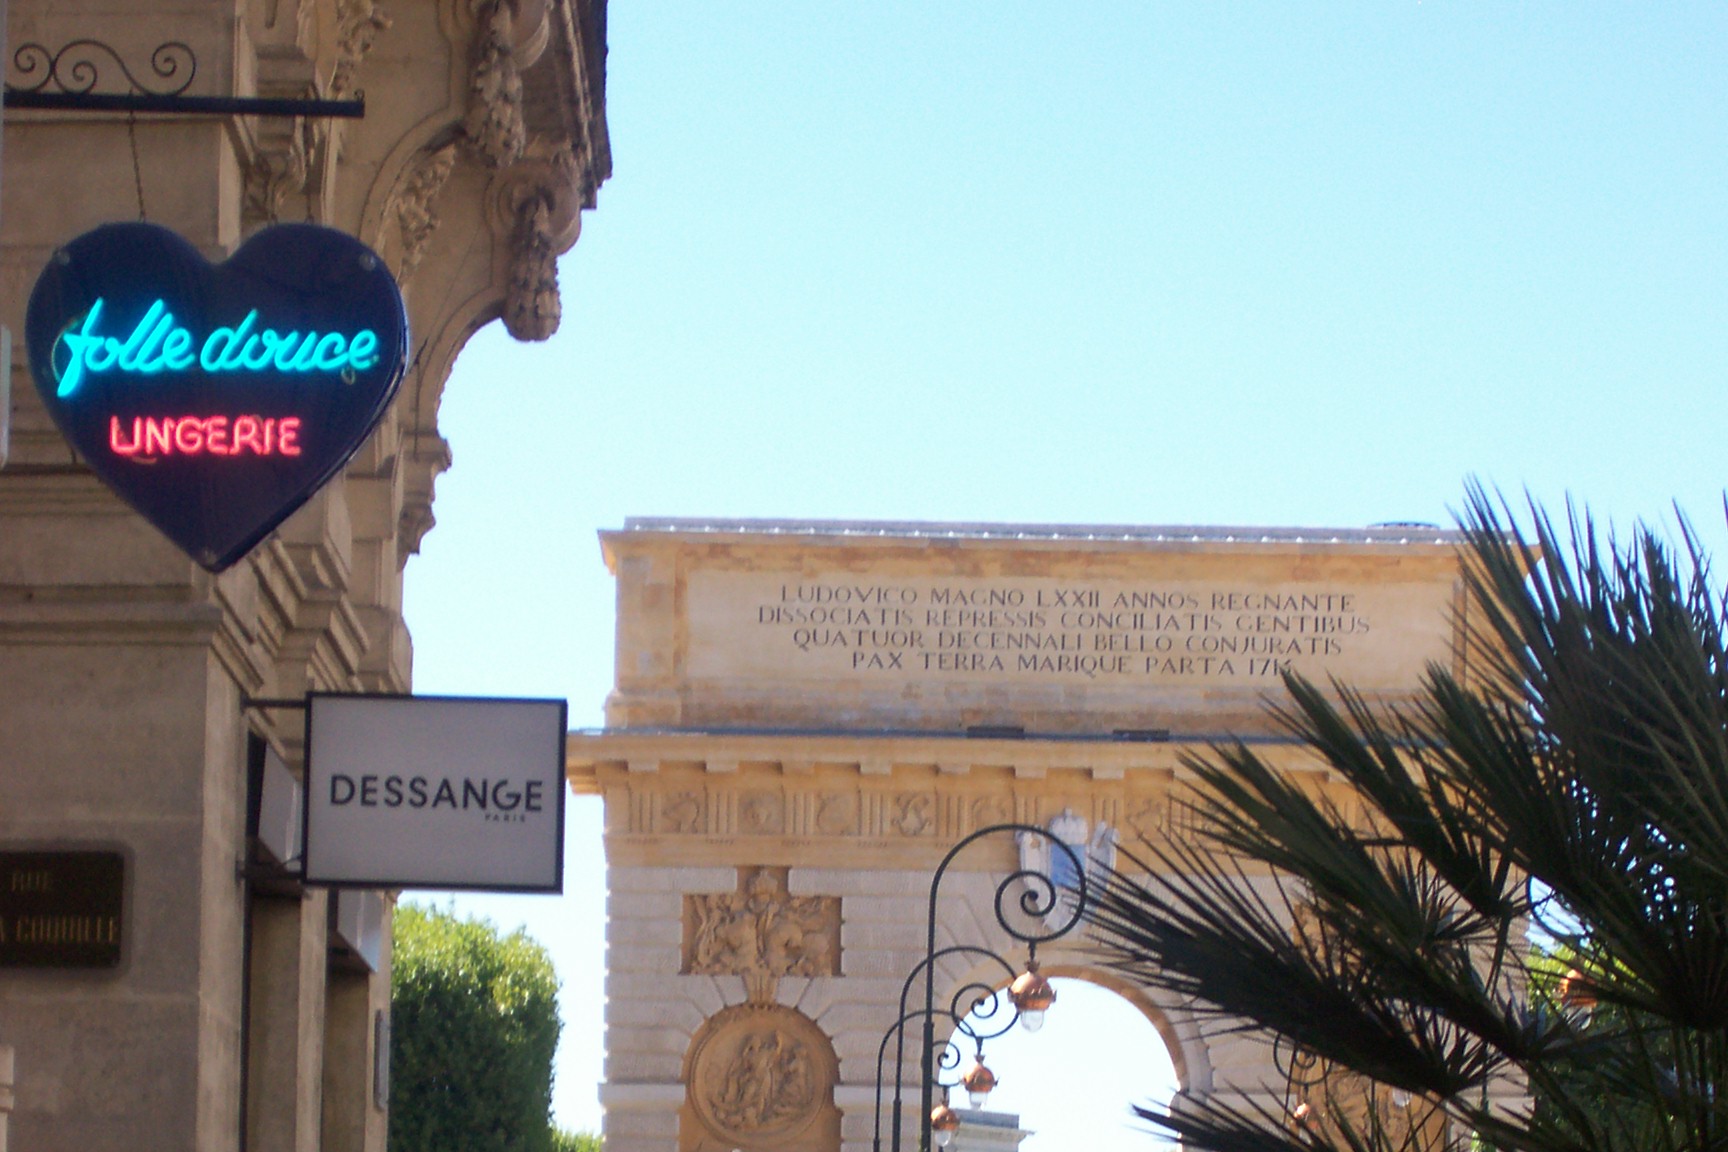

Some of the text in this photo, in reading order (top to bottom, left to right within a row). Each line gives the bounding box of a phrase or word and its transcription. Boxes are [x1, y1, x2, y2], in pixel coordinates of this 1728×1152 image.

[57, 296, 378, 397] folle douce
[109, 414, 302, 457] LINGERIE
[782, 585, 1356, 613] LUDOVICO MAGNO LXXII ANNOS REGNANTE
[758, 605, 1370, 634] DISSOCIATIS REPRESSIS CONCILIATIS GENTIBUS
[793, 627, 1342, 656] QUATUOR DECENNALI BELLO CONJURATIS
[853, 651, 903, 671] PAX
[919, 651, 1005, 672] TERRA
[1018, 653, 1132, 679] MARIQUE
[1145, 656, 1235, 676] PARTA
[329, 774, 543, 812] DESSANGE
[485, 813, 526, 823] PARIS
